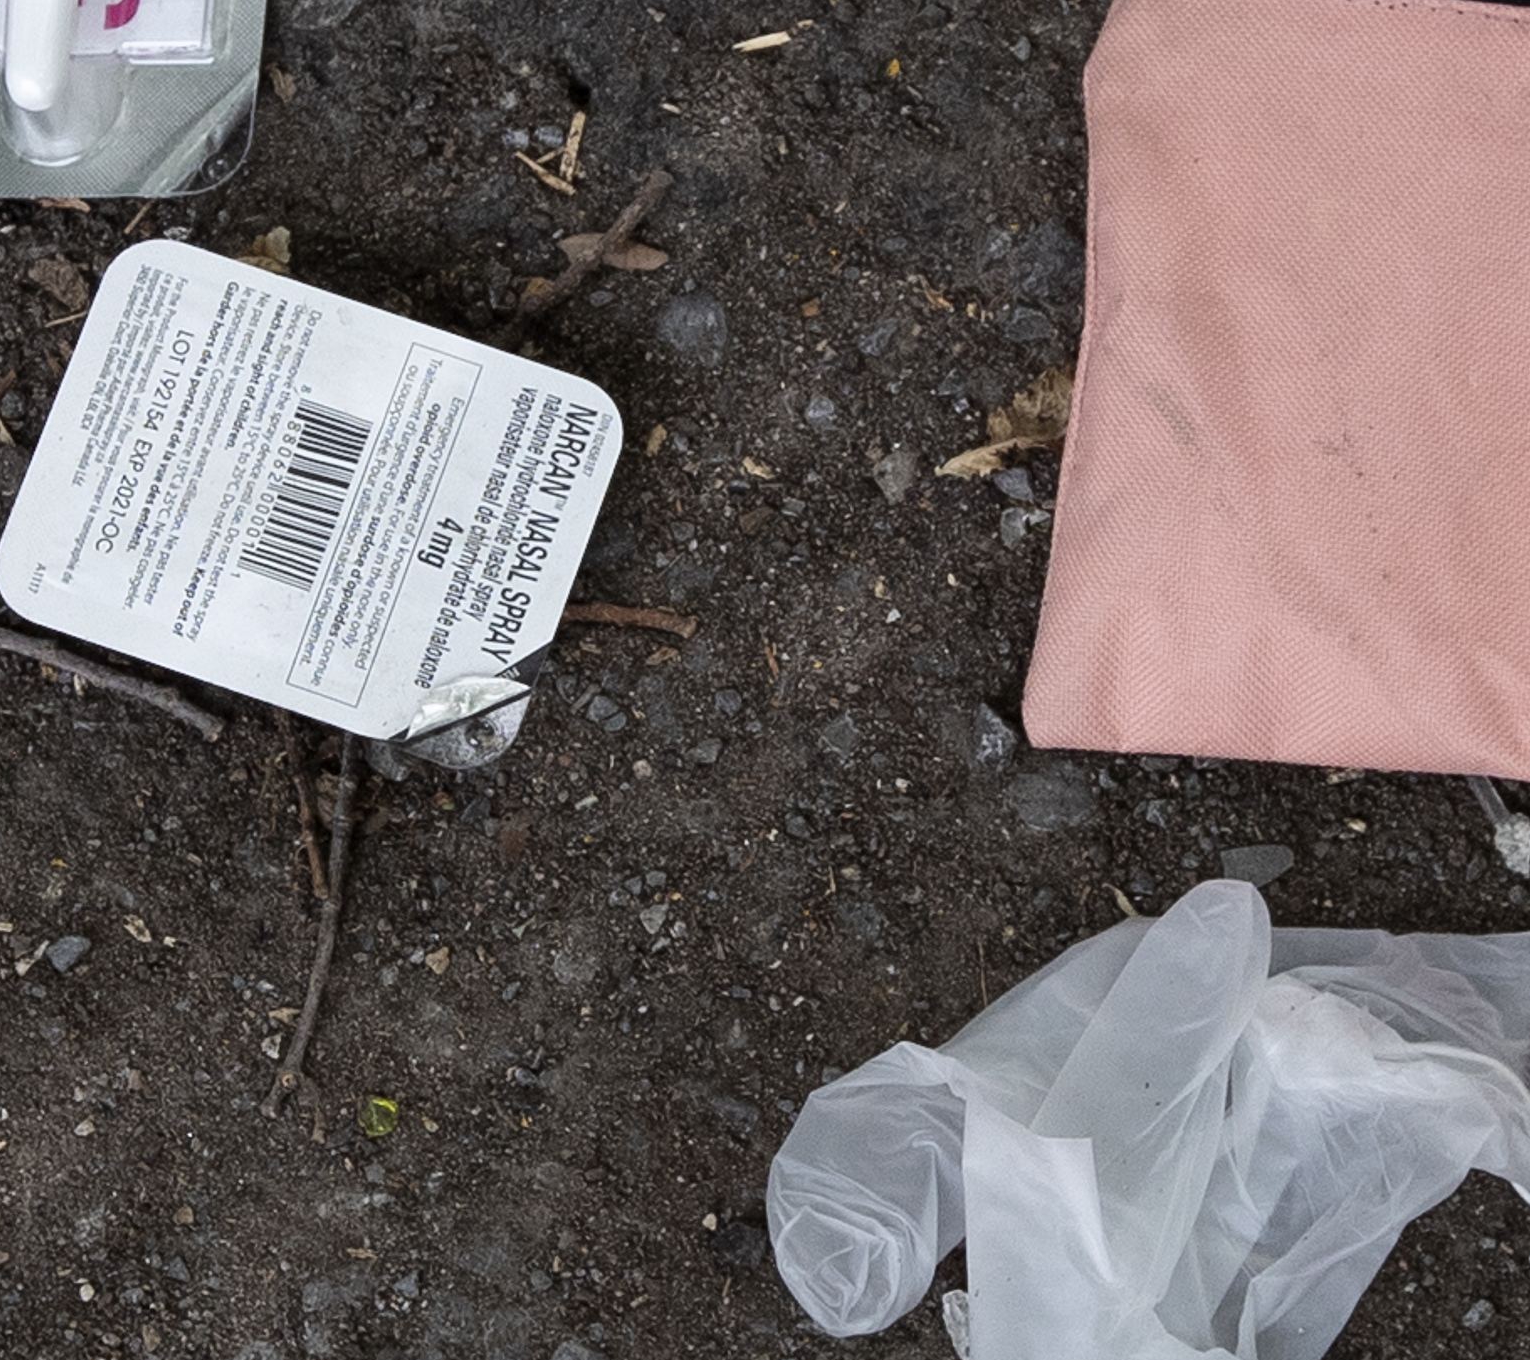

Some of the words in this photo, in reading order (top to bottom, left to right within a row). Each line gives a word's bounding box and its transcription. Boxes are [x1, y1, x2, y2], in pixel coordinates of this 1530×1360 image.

[216, 281, 240, 321] Garder
[269, 299, 288, 331] reach
[205, 320, 225, 348] hors
[283, 304, 307, 341] device.
[305, 309, 323, 327] Do
[168, 329, 195, 365] LOT
[260, 330, 276, 355] and
[299, 327, 314, 347] not
[194, 365, 209, 377] la
[198, 349, 213, 365] de
[249, 353, 268, 385] sight
[271, 342, 292, 372] Store
[283, 347, 306, 390] remove
[405, 364, 419, 382] ou
[143, 370, 180, 431] 192154
[179, 377, 201, 419] portée
[244, 385, 256, 401] of
[253, 372, 281, 423] between
[275, 390, 291, 411] the
[300, 384, 312, 394] 8
[409, 359, 443, 421] Traitement
[173, 419, 185, 433] et
[224, 399, 251, 450] children.
[261, 411, 282, 443] spray
[376, 383, 412, 456] soupçonnée.
[418, 403, 441, 446] opioid
[428, 397, 465, 464] Emergency
[496, 387, 537, 469] vaporisateur
[527, 394, 563, 455] naloxone
[128, 438, 153, 473] EXP
[162, 450, 177, 462] la
[166, 433, 182, 454] de
[237, 451, 251, 465] to
[267, 420, 301, 483] 88062
[386, 420, 417, 481] d'urgence
[153, 463, 169, 483] vue
[249, 442, 271, 480] device
[366, 458, 387, 488] Pour
[395, 445, 426, 506] overdose.
[145, 484, 161, 505] des
[219, 493, 236, 510] Do
[240, 480, 256, 506] until
[373, 480, 396, 515] d'une
[408, 464, 439, 523] treatment
[481, 468, 508, 508] nasal
[489, 456, 545, 546] hydrochloride
[95, 474, 139, 554] 2021-OC
[126, 507, 151, 552] enfants.
[211, 510, 227, 530] not
[230, 504, 247, 526] use.
[241, 492, 274, 549] 00001
[344, 487, 373, 546] utilisation
[388, 507, 406, 529] For
[436, 517, 465, 534] 4
[474, 505, 499, 525] de
[223, 526, 240, 545] Do
[353, 515, 381, 568] surdose
[378, 528, 395, 552] use
[399, 535, 411, 545] a
[404, 522, 416, 539] of
[507, 510, 559, 582] NASAL
[197, 530, 221, 565] freeze.
[215, 544, 231, 565] not
[373, 551, 389, 566] in
[417, 531, 453, 569] mg
[207, 565, 224, 588] test
[328, 546, 351, 587] nasale
[365, 566, 383, 589] the
[383, 546, 410, 590] known
[444, 525, 491, 607] chlorhydrate
[480, 544, 508, 585] nasal
[184, 567, 206, 599] Keep
[199, 588, 216, 609] the
[378, 590, 391, 606] or
[176, 599, 192, 622] out
[329, 568, 363, 637] d'opioïdes
[354, 588, 373, 620] nose
[436, 607, 462, 627] de
[462, 581, 494, 622] spray
[172, 622, 184, 638] of
[186, 610, 206, 642] spray
[299, 587, 336, 666] uniquement.
[341, 620, 361, 649] only.
[354, 606, 385, 671] suspected
[481, 587, 531, 664] SPRAY
[310, 639, 336, 687] connue
[414, 627, 450, 689] naloxone
